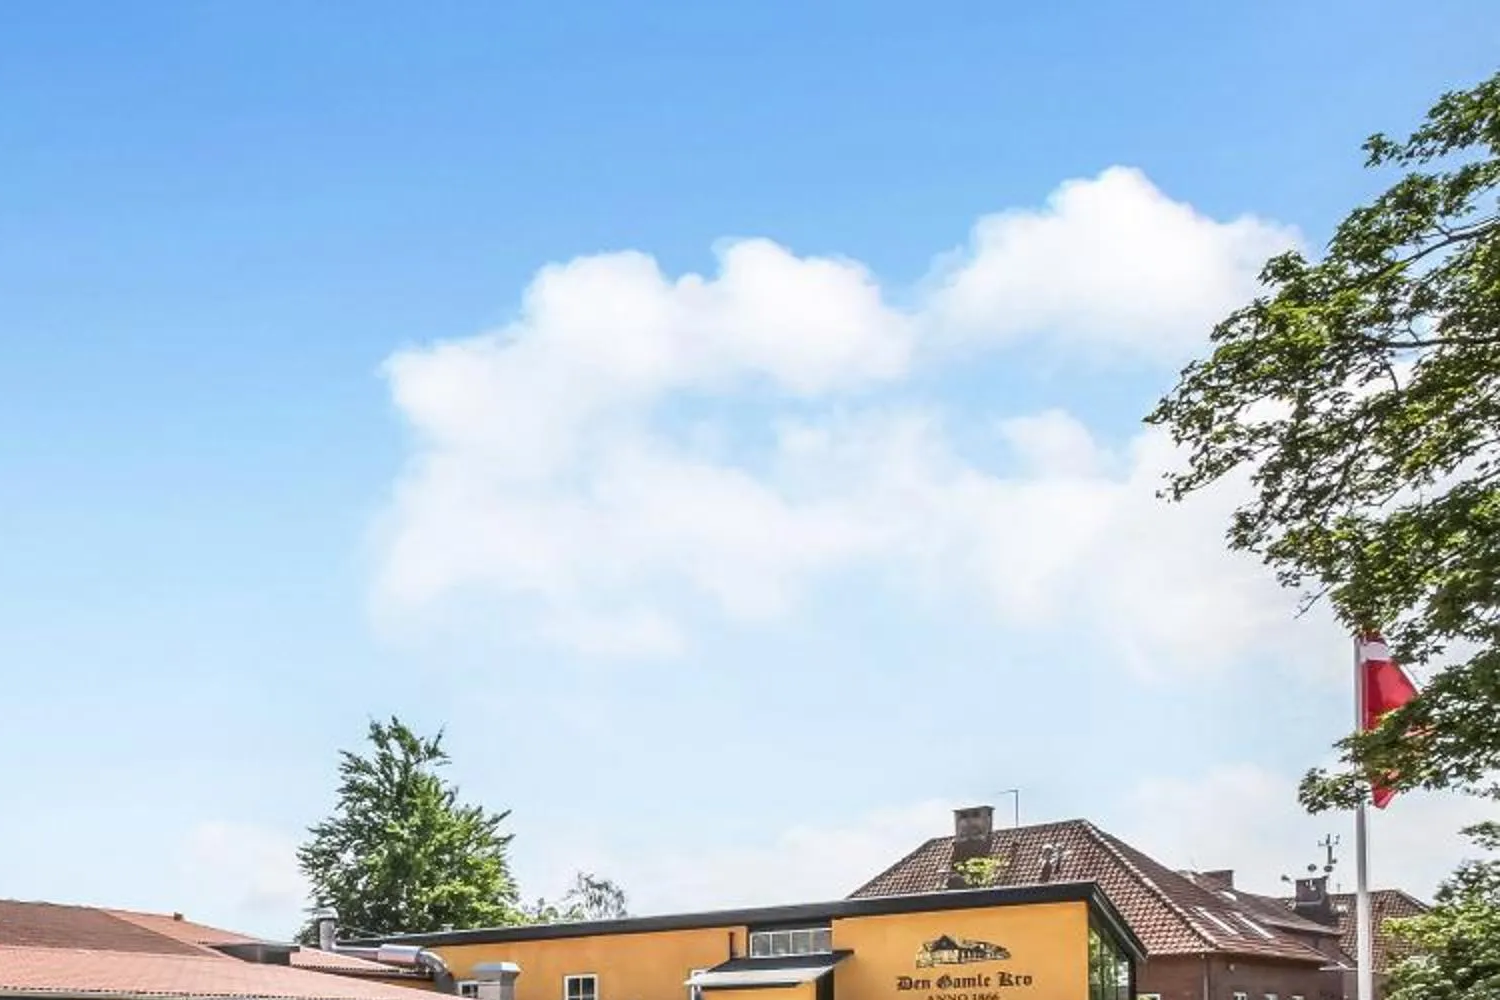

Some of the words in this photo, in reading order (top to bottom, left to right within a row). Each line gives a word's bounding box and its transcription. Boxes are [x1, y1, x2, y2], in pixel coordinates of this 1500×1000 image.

[897, 976, 931, 990] Den
[936, 973, 991, 989] Gamle
[997, 971, 1033, 987] Kro
